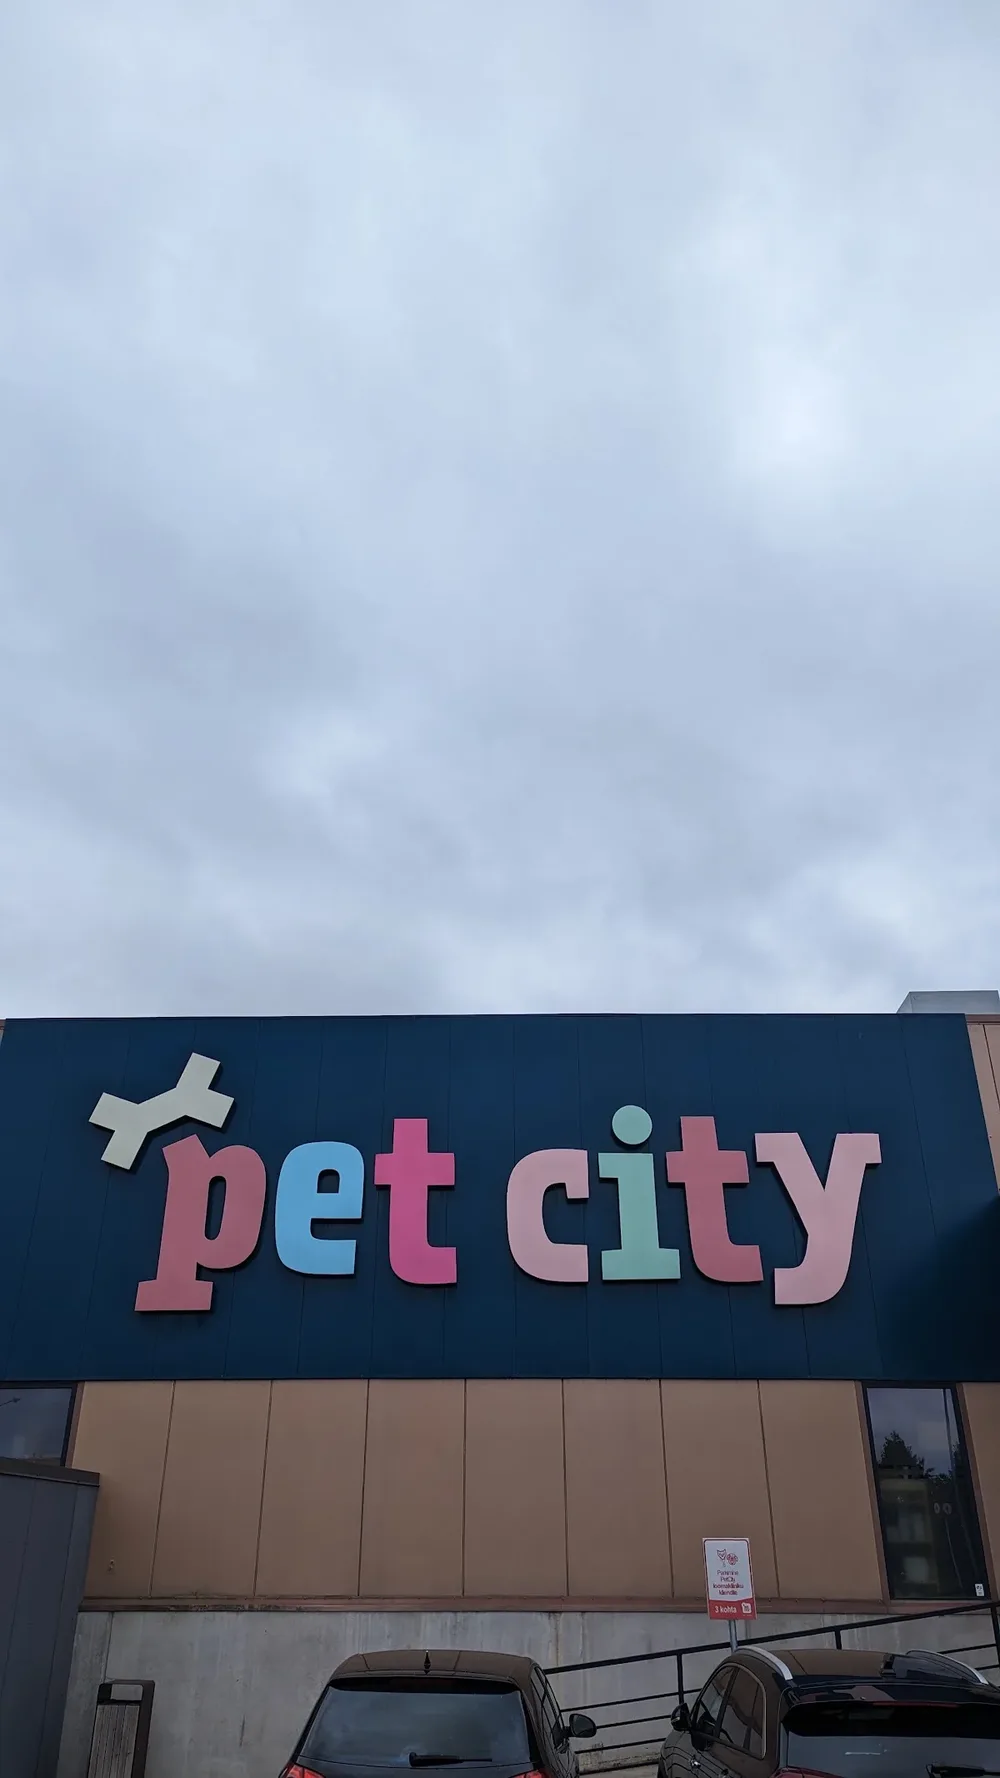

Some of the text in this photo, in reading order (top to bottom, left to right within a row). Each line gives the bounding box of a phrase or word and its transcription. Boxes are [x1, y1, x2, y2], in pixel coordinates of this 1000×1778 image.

[135, 1104, 882, 1312] pet city
[714, 1605, 719, 1613] 3
[720, 1605, 737, 1614] kohta
